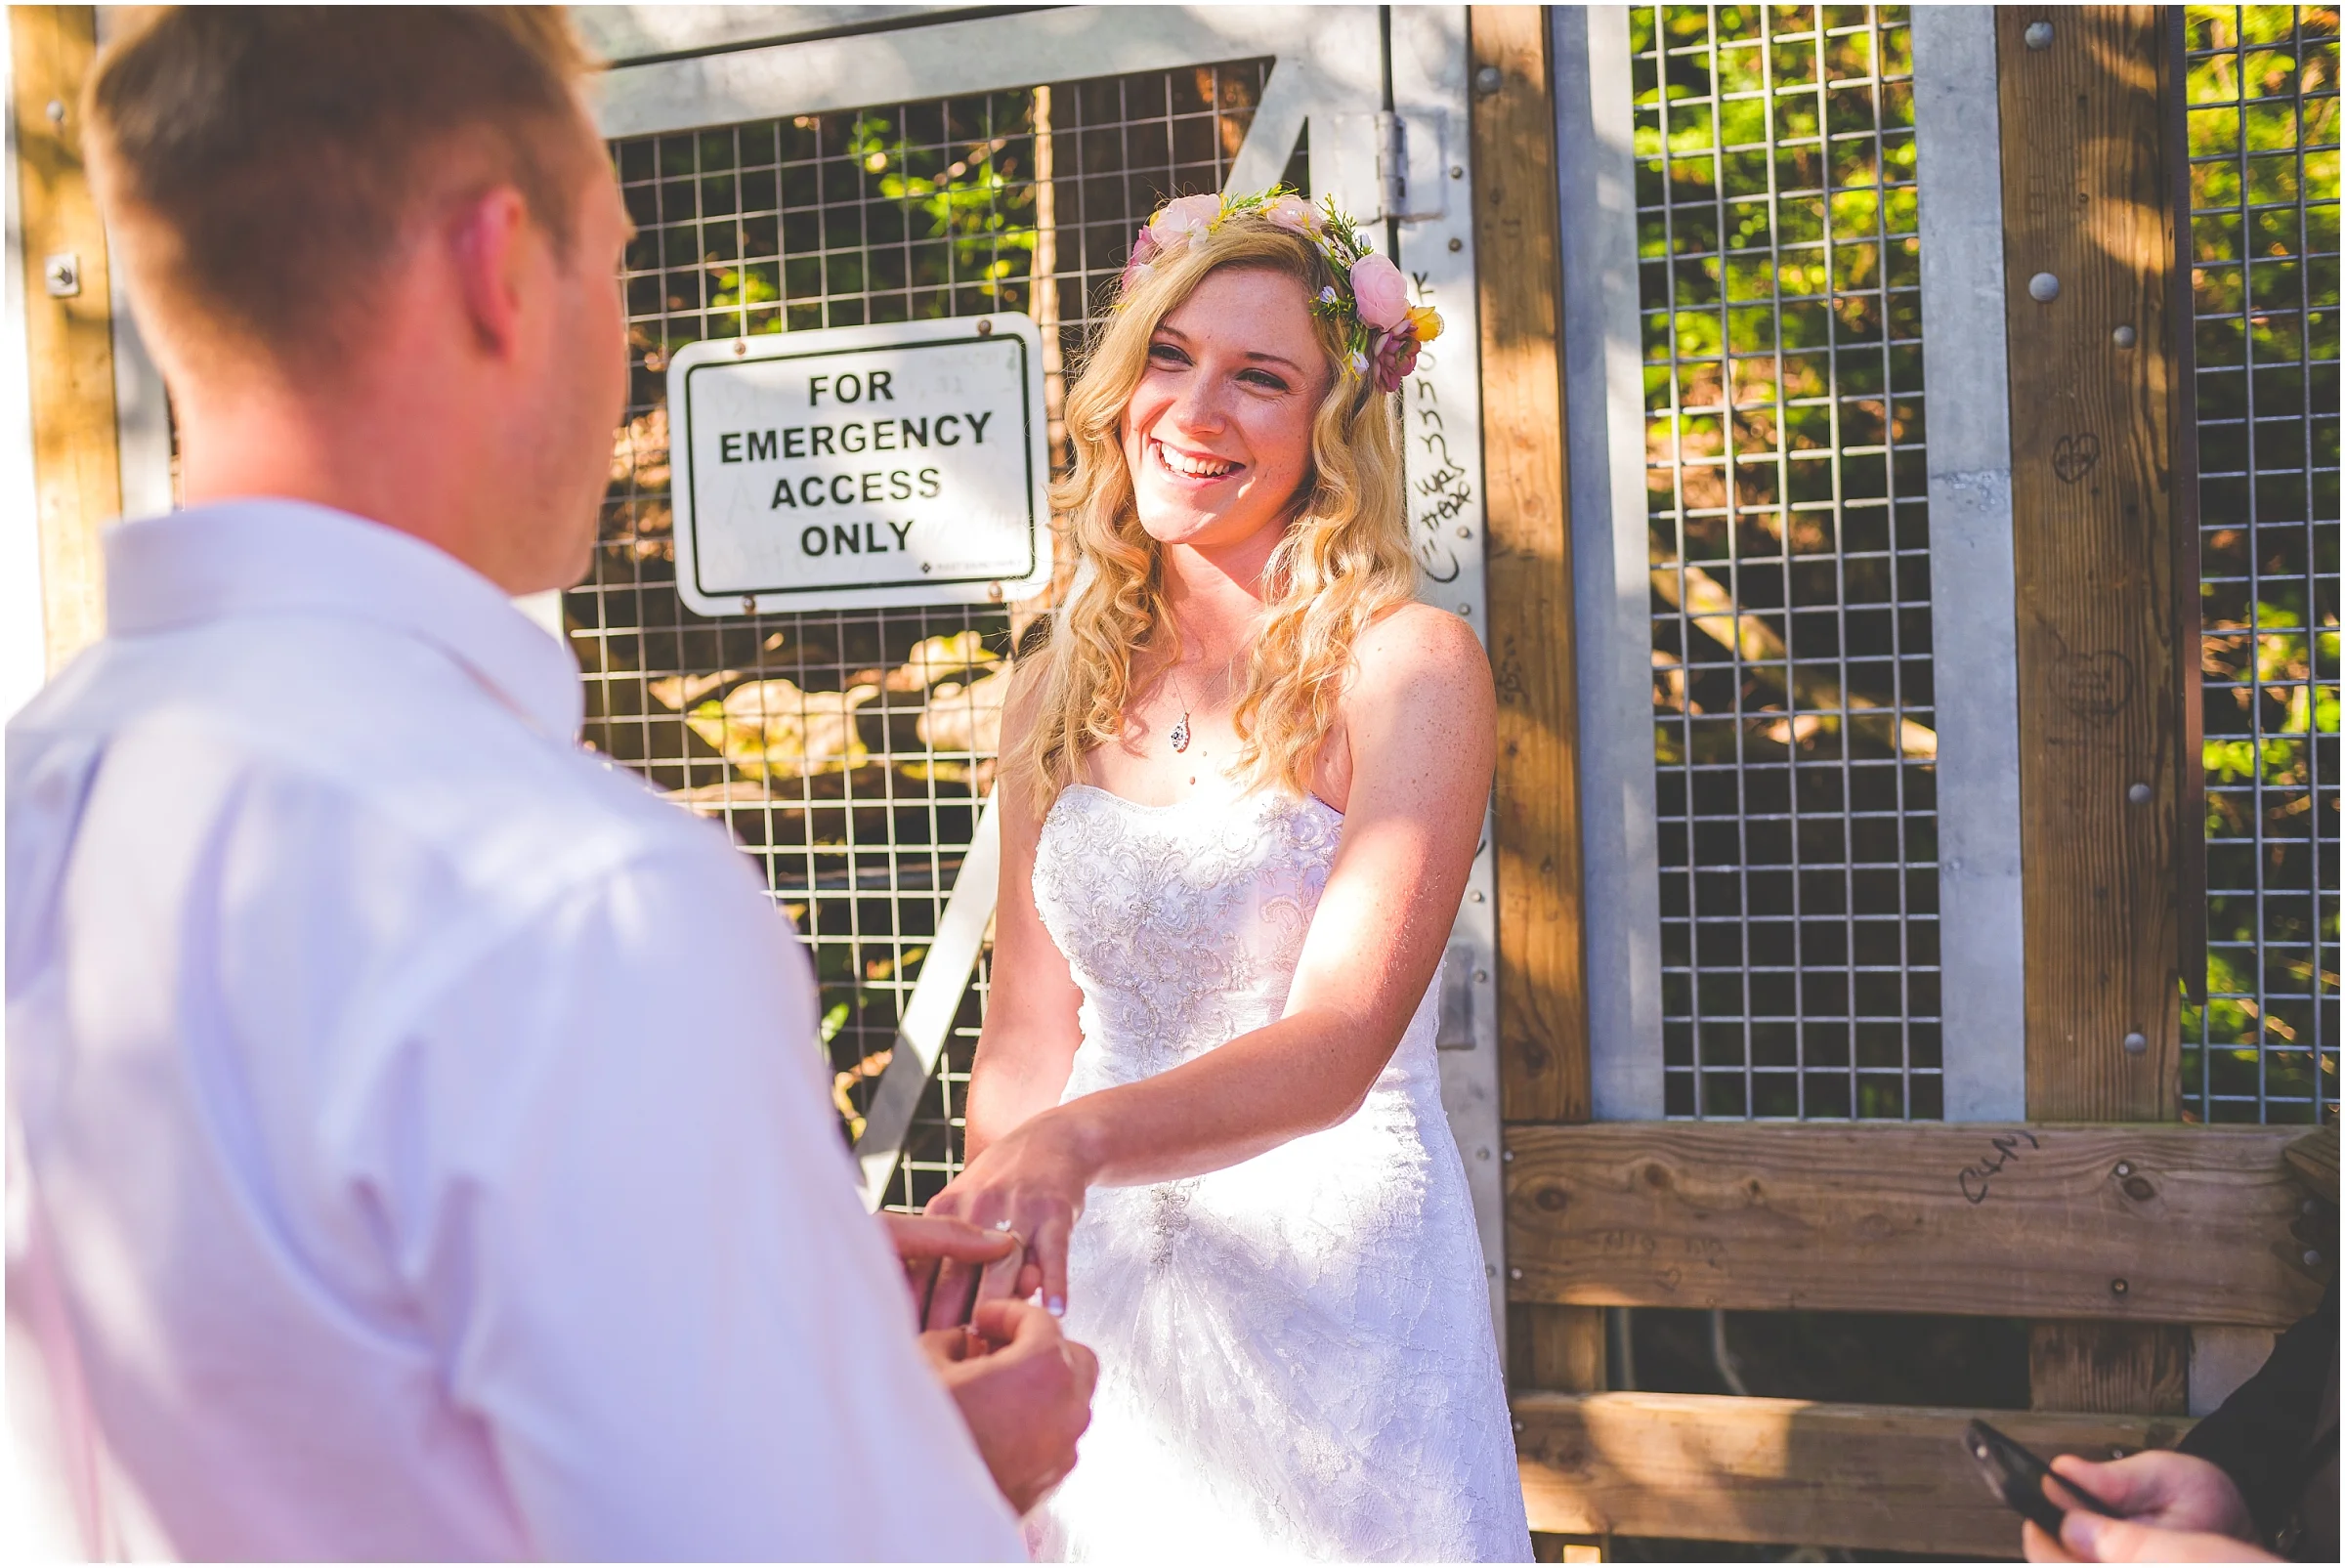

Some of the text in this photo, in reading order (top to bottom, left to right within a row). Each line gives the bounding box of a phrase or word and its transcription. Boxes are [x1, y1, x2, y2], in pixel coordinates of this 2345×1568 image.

[809, 370, 894, 407] FOR
[720, 411, 993, 464] EMERGENCY
[771, 468, 941, 510] ACCESS
[801, 521, 914, 557] ONLY
